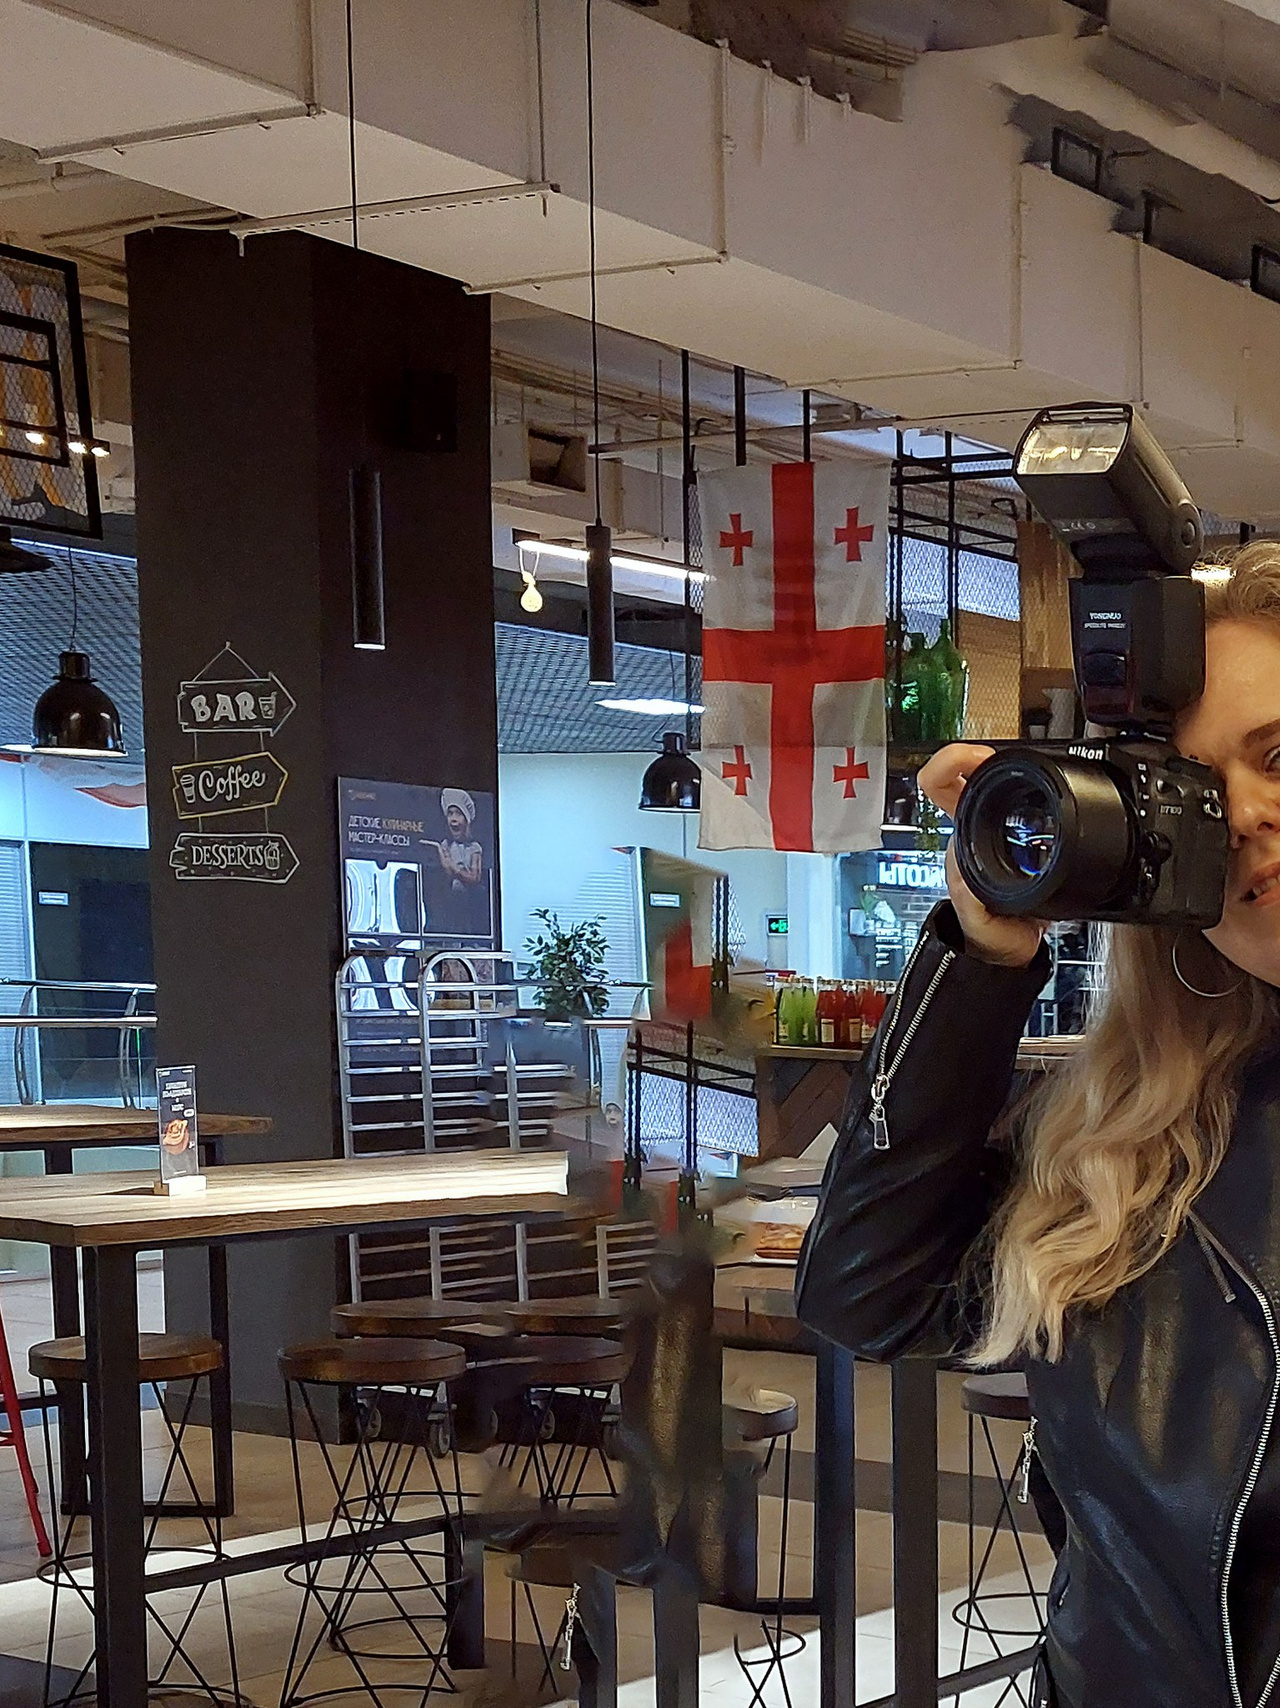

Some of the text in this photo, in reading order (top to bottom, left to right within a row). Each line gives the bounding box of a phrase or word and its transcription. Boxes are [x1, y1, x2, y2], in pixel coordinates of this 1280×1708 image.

[190, 691, 257, 722] BAR
[1068, 746, 1104, 760] Nikon
[199, 764, 266, 802] Coffee
[348, 814, 382, 829] ДЕТСКИЕ
[191, 844, 264, 869] DESSERTS
